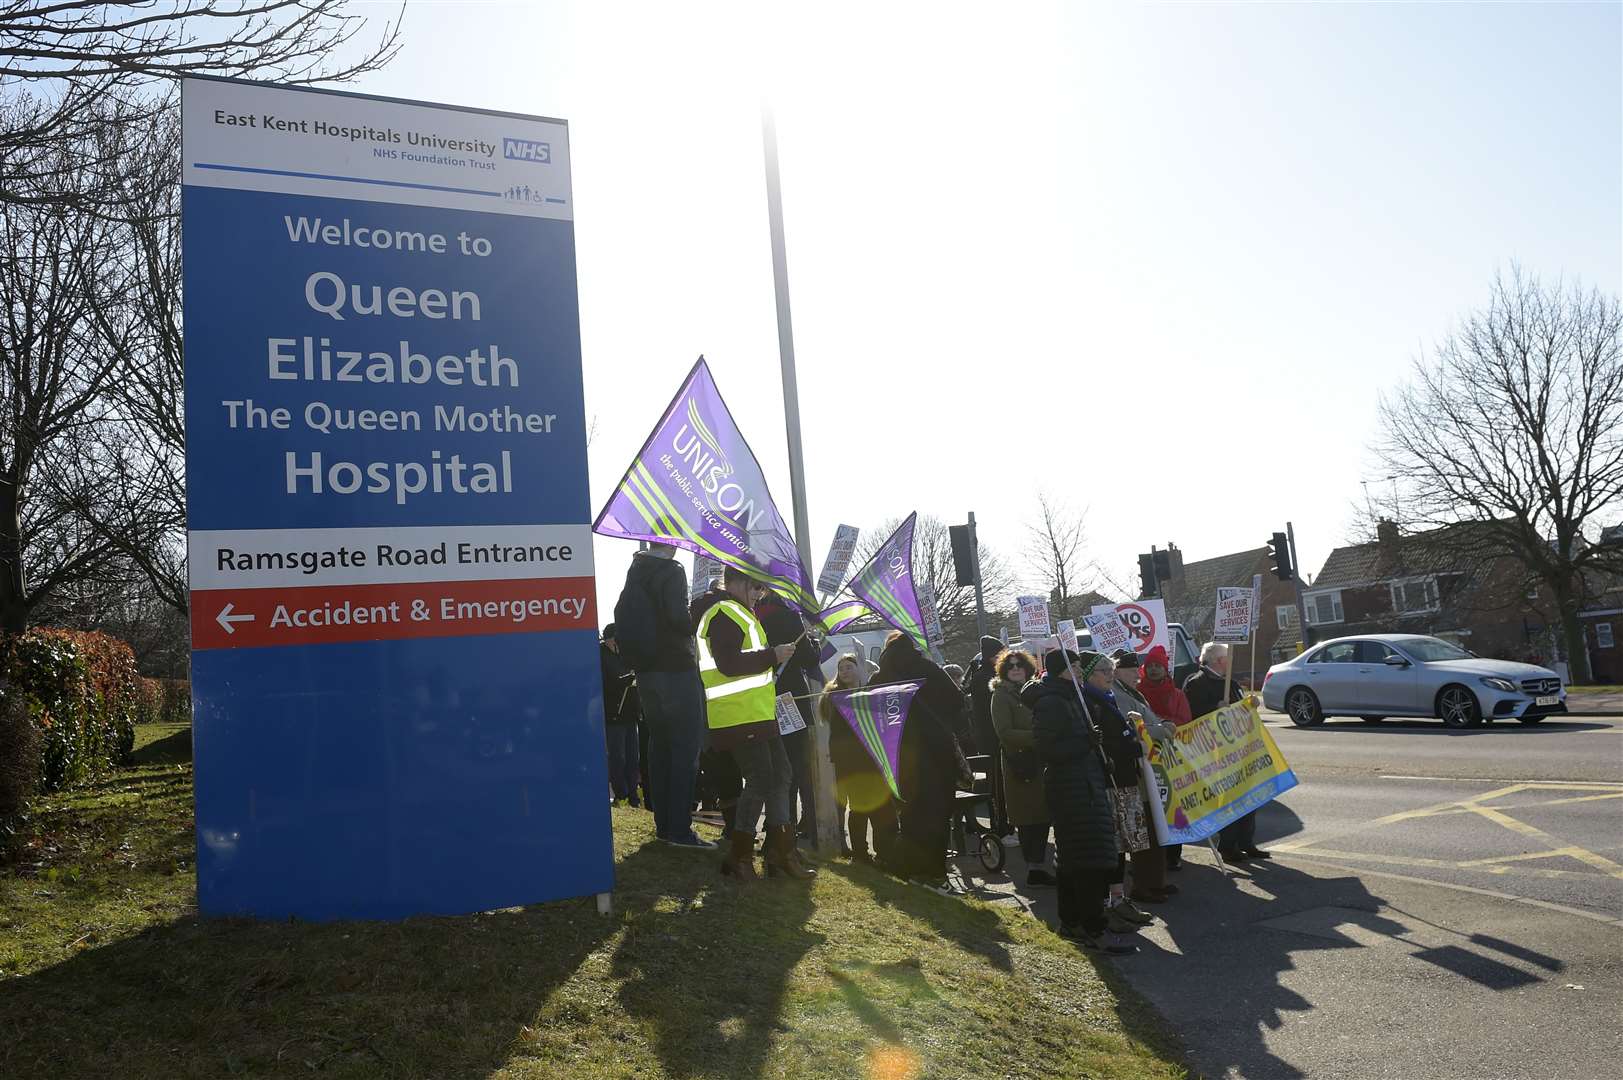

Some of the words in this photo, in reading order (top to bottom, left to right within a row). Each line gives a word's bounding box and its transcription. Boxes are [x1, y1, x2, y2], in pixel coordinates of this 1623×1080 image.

[214, 109, 257, 129] East
[262, 115, 308, 134] Kent
[314, 120, 402, 145] Hospitals
[407, 131, 497, 158] University
[373, 147, 400, 160] NHS
[400, 150, 466, 169] Foundation
[468, 158, 497, 171] Trust
[504, 139, 550, 163] NHS
[284, 215, 447, 254] Welcome
[457, 231, 493, 257] to
[304, 270, 482, 321] Queen
[267, 335, 520, 388] Elizabeth
[221, 399, 291, 430] The
[304, 401, 421, 434] Queen
[434, 404, 557, 434] Mother
[285, 450, 513, 504] Hospital
[672, 424, 765, 532] UNISON
[659, 453, 674, 471] the
[671, 469, 694, 499] public
[691, 494, 722, 530] service
[719, 525, 752, 554] union
[217, 546, 366, 575] Ramsgate
[376, 541, 447, 567] Road
[457, 542, 573, 565] Entrance
[269, 600, 400, 629] Accident
[410, 599, 431, 621] &
[440, 596, 587, 623] Emergency
[1118, 611, 1142, 626] NO
[1220, 599, 1234, 610] SAVE
[1235, 599, 1248, 608] OUR
[1226, 607, 1249, 618] STROKE
[1091, 623, 1106, 636] SAVE
[1105, 620, 1119, 630] OUR
[1101, 627, 1125, 641] STROKE
[1220, 616, 1249, 628] SERVICES
[1100, 634, 1128, 650] SERVICES
